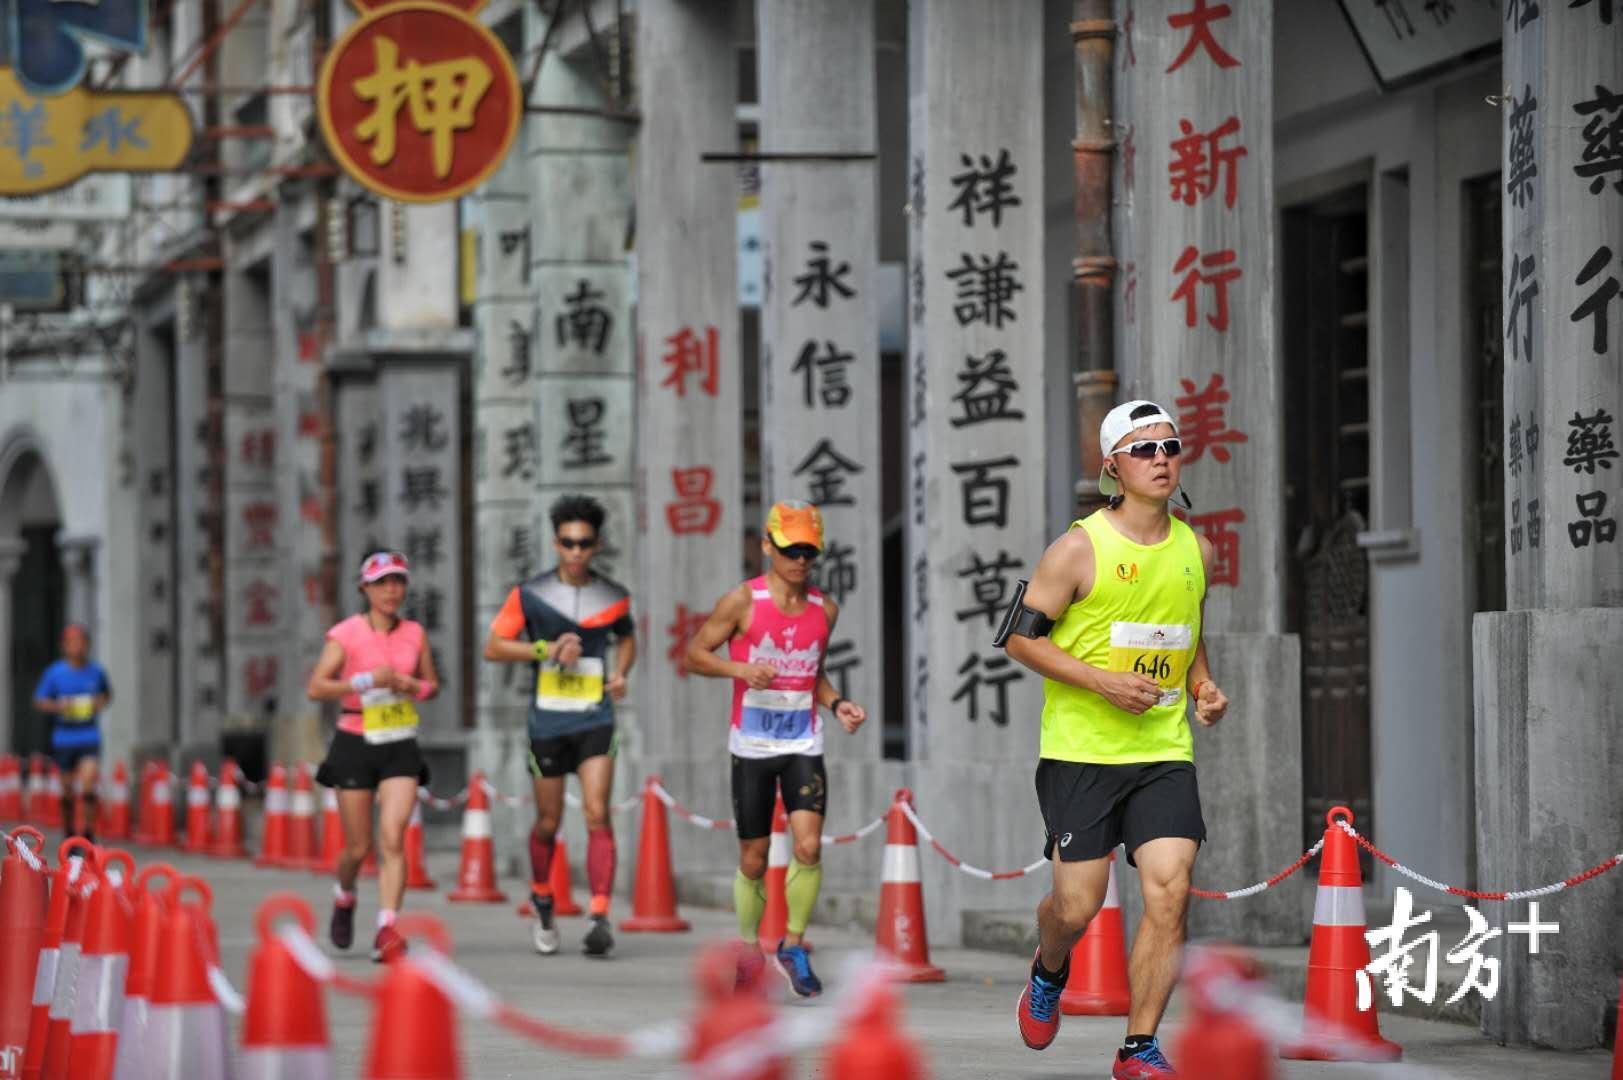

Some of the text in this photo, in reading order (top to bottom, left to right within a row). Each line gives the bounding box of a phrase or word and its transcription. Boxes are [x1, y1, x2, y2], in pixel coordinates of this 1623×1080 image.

[353, 36, 493, 180] 押
[555, 277, 618, 576] 南星
[945, 148, 1025, 727] 祥謙益百草行
[1563, 409, 1620, 549] 藥品
[761, 712, 796, 732] 074
[1133, 653, 1172, 680] 646
